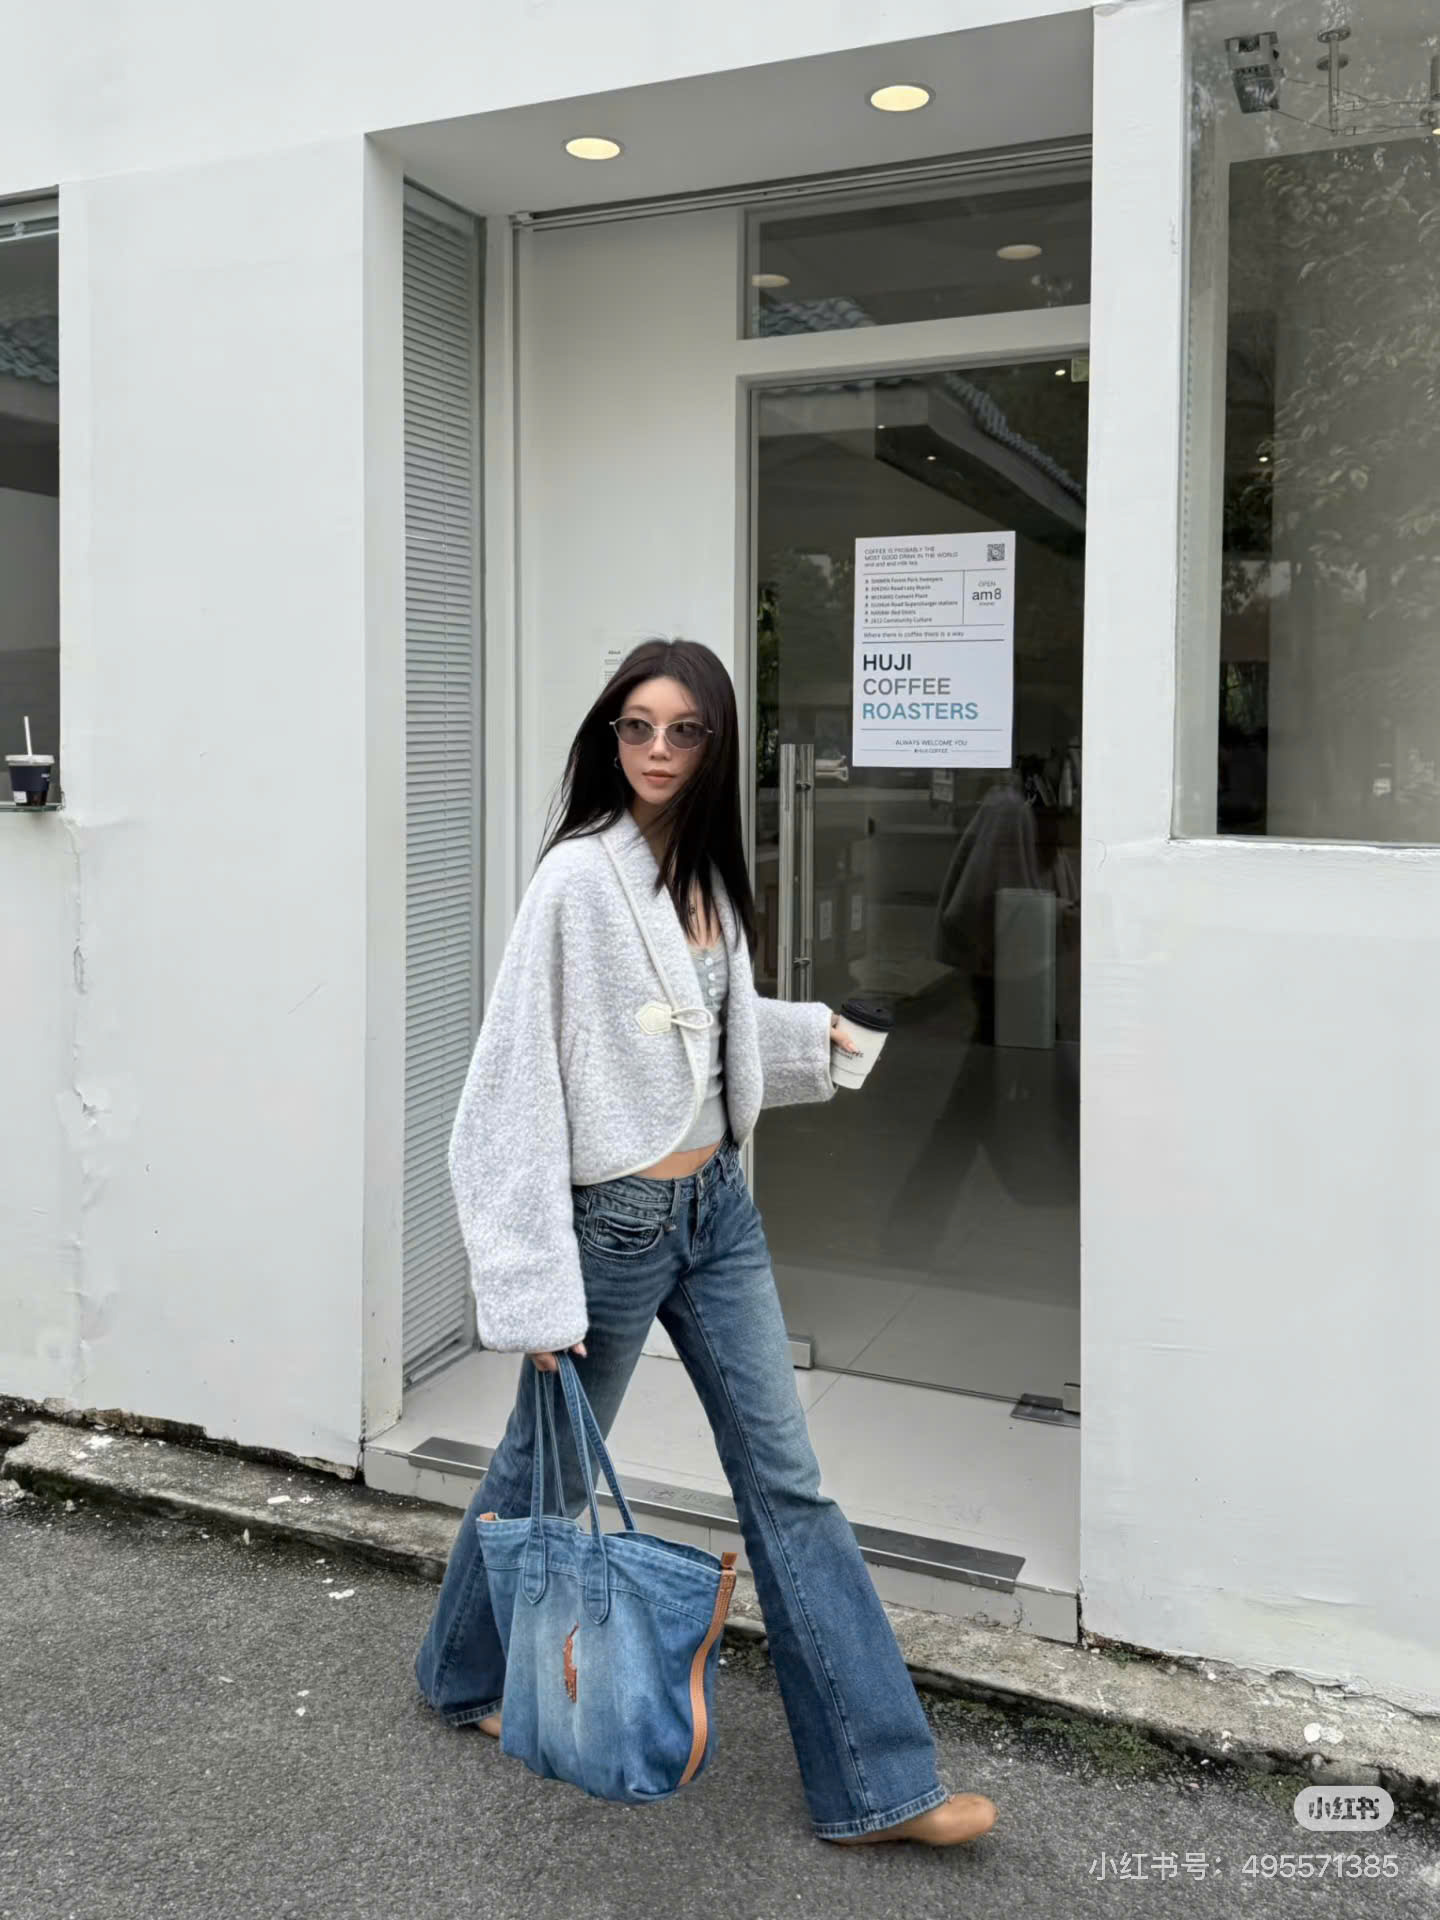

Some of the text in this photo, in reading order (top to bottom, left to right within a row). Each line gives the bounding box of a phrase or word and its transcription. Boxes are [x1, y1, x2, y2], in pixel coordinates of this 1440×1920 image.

[863, 653, 911, 671] HUJI
[863, 678, 951, 695] COFFEE
[862, 702, 979, 720] ROASTERS
